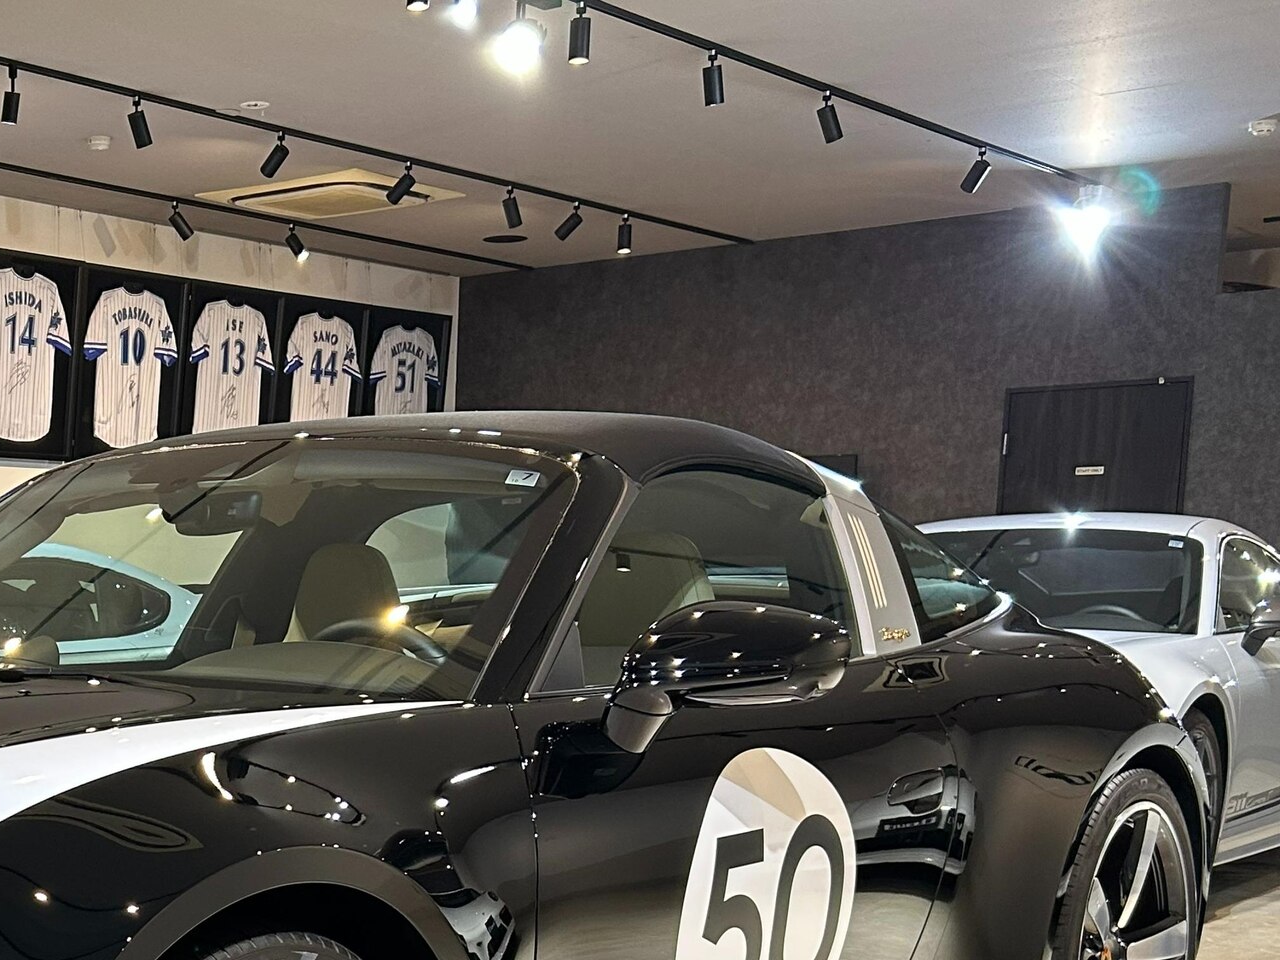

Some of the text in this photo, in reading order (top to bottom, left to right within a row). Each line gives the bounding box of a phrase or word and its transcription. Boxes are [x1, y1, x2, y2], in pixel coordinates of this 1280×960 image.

[4, 291, 42, 313] ISHIDA
[5, 312, 37, 356] 14
[226, 319, 244, 333] ISE
[313, 330, 339, 346] SANO
[120, 326, 146, 366] 10
[221, 337, 246, 377] 13
[310, 348, 338, 386] 44
[395, 358, 417, 393] 51
[522, 472, 534, 481] 7
